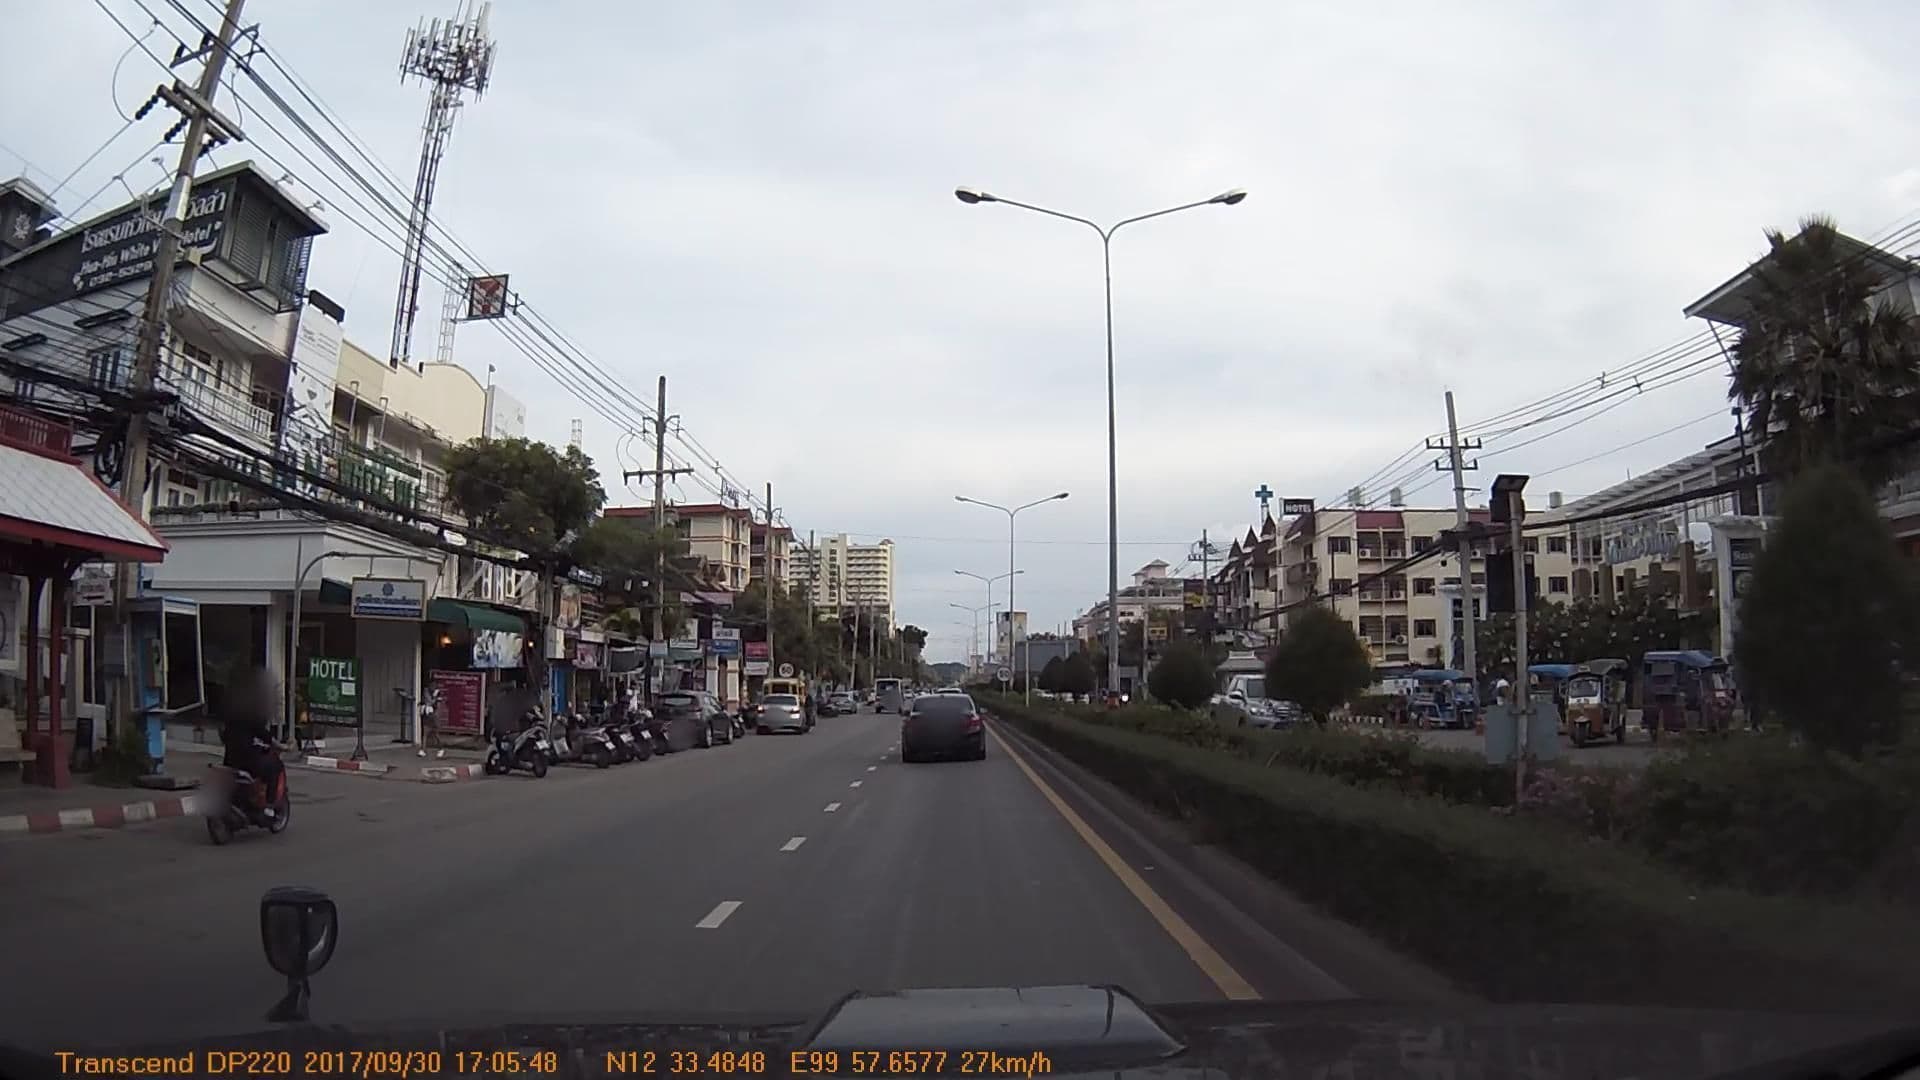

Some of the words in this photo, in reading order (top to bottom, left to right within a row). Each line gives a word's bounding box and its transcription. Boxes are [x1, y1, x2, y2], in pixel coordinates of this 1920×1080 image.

[120, 242, 150, 262] White
[1284, 503, 1312, 513] HOTEL
[310, 659, 357, 681] HOTEL
